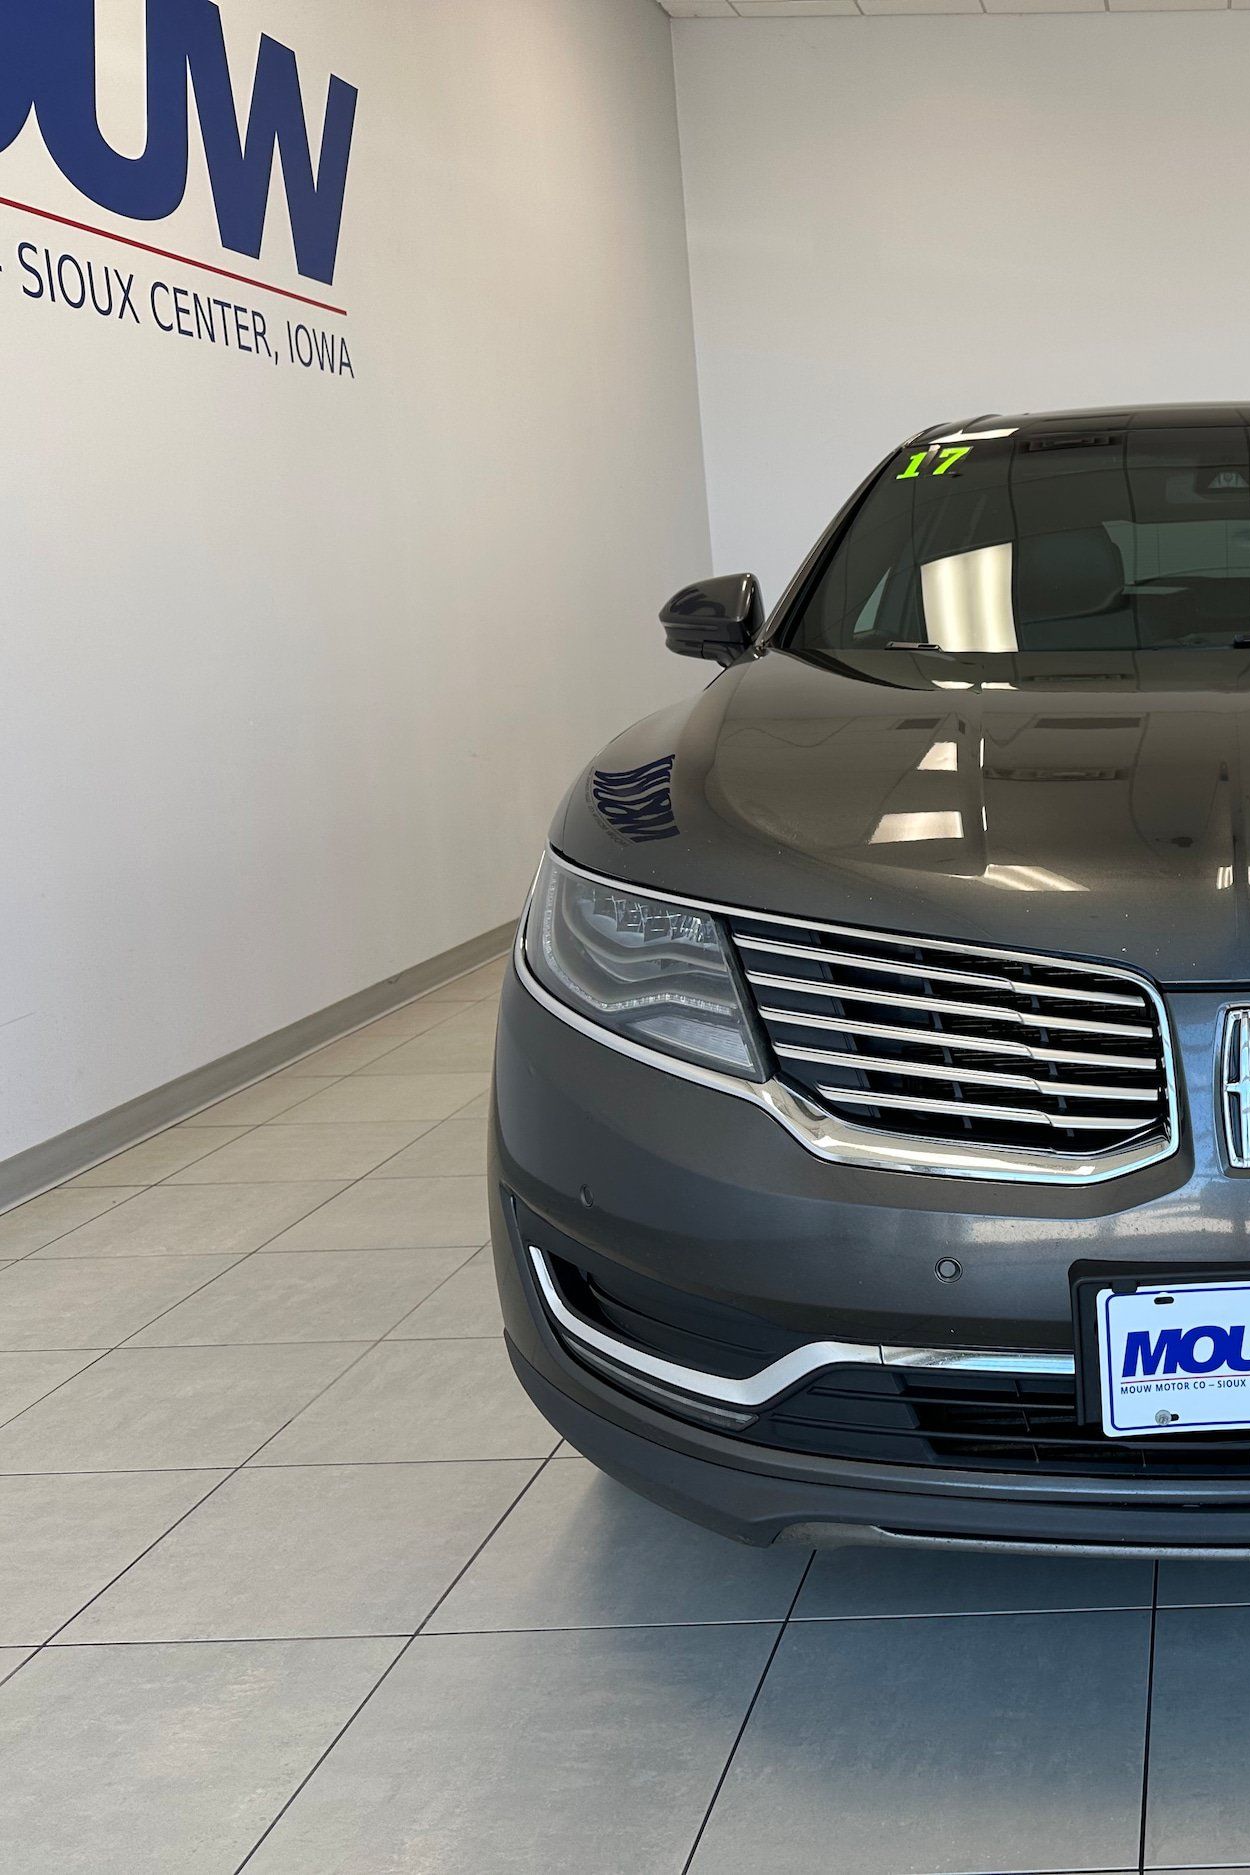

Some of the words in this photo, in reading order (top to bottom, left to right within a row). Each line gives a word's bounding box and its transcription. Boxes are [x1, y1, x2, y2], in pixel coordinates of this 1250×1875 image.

[0, 0, 358, 286] UW
[17, 241, 140, 324] SIOUX
[150, 281, 279, 366] CENTER,
[286, 320, 355, 379] IOWA
[896, 446, 972, 480] 17
[1120, 1384, 1152, 1395] MOUW
[1155, 1382, 1190, 1393] MOTOR
[1193, 1381, 1206, 1390] CO
[1217, 1379, 1247, 1389] SIOUX
